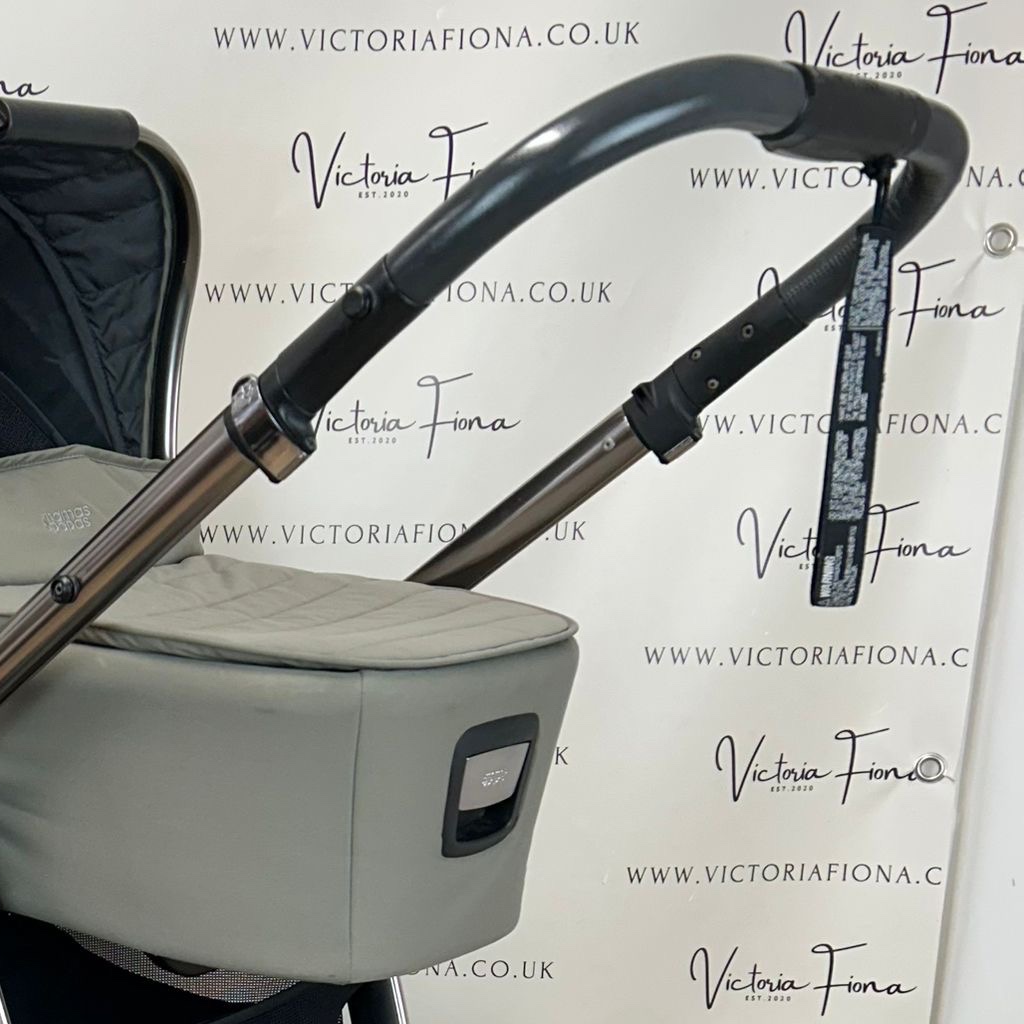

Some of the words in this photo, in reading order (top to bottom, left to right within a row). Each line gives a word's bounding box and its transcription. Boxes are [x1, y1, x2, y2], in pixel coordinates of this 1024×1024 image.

[213, 20, 640, 52] WWW.VICTORIAFIONA.CO.UK
[785, 10, 925, 66] Victoria
[292, 131, 429, 209] Victoria
[359, 190, 409, 198] EST.2020
[898, 259, 1004, 347] Fiona
[417, 373, 521, 459] Fiona
[865, 501, 971, 583] Fiona
[644, 646, 969, 667] WWW.VICTORIAFIONA.C
[716, 735, 832, 802] Victoria
[627, 864, 942, 885] WWW.VICTORIAFIONA.C
[690, 946, 810, 1010] Victoria
[811, 943, 917, 1016] Fiona
